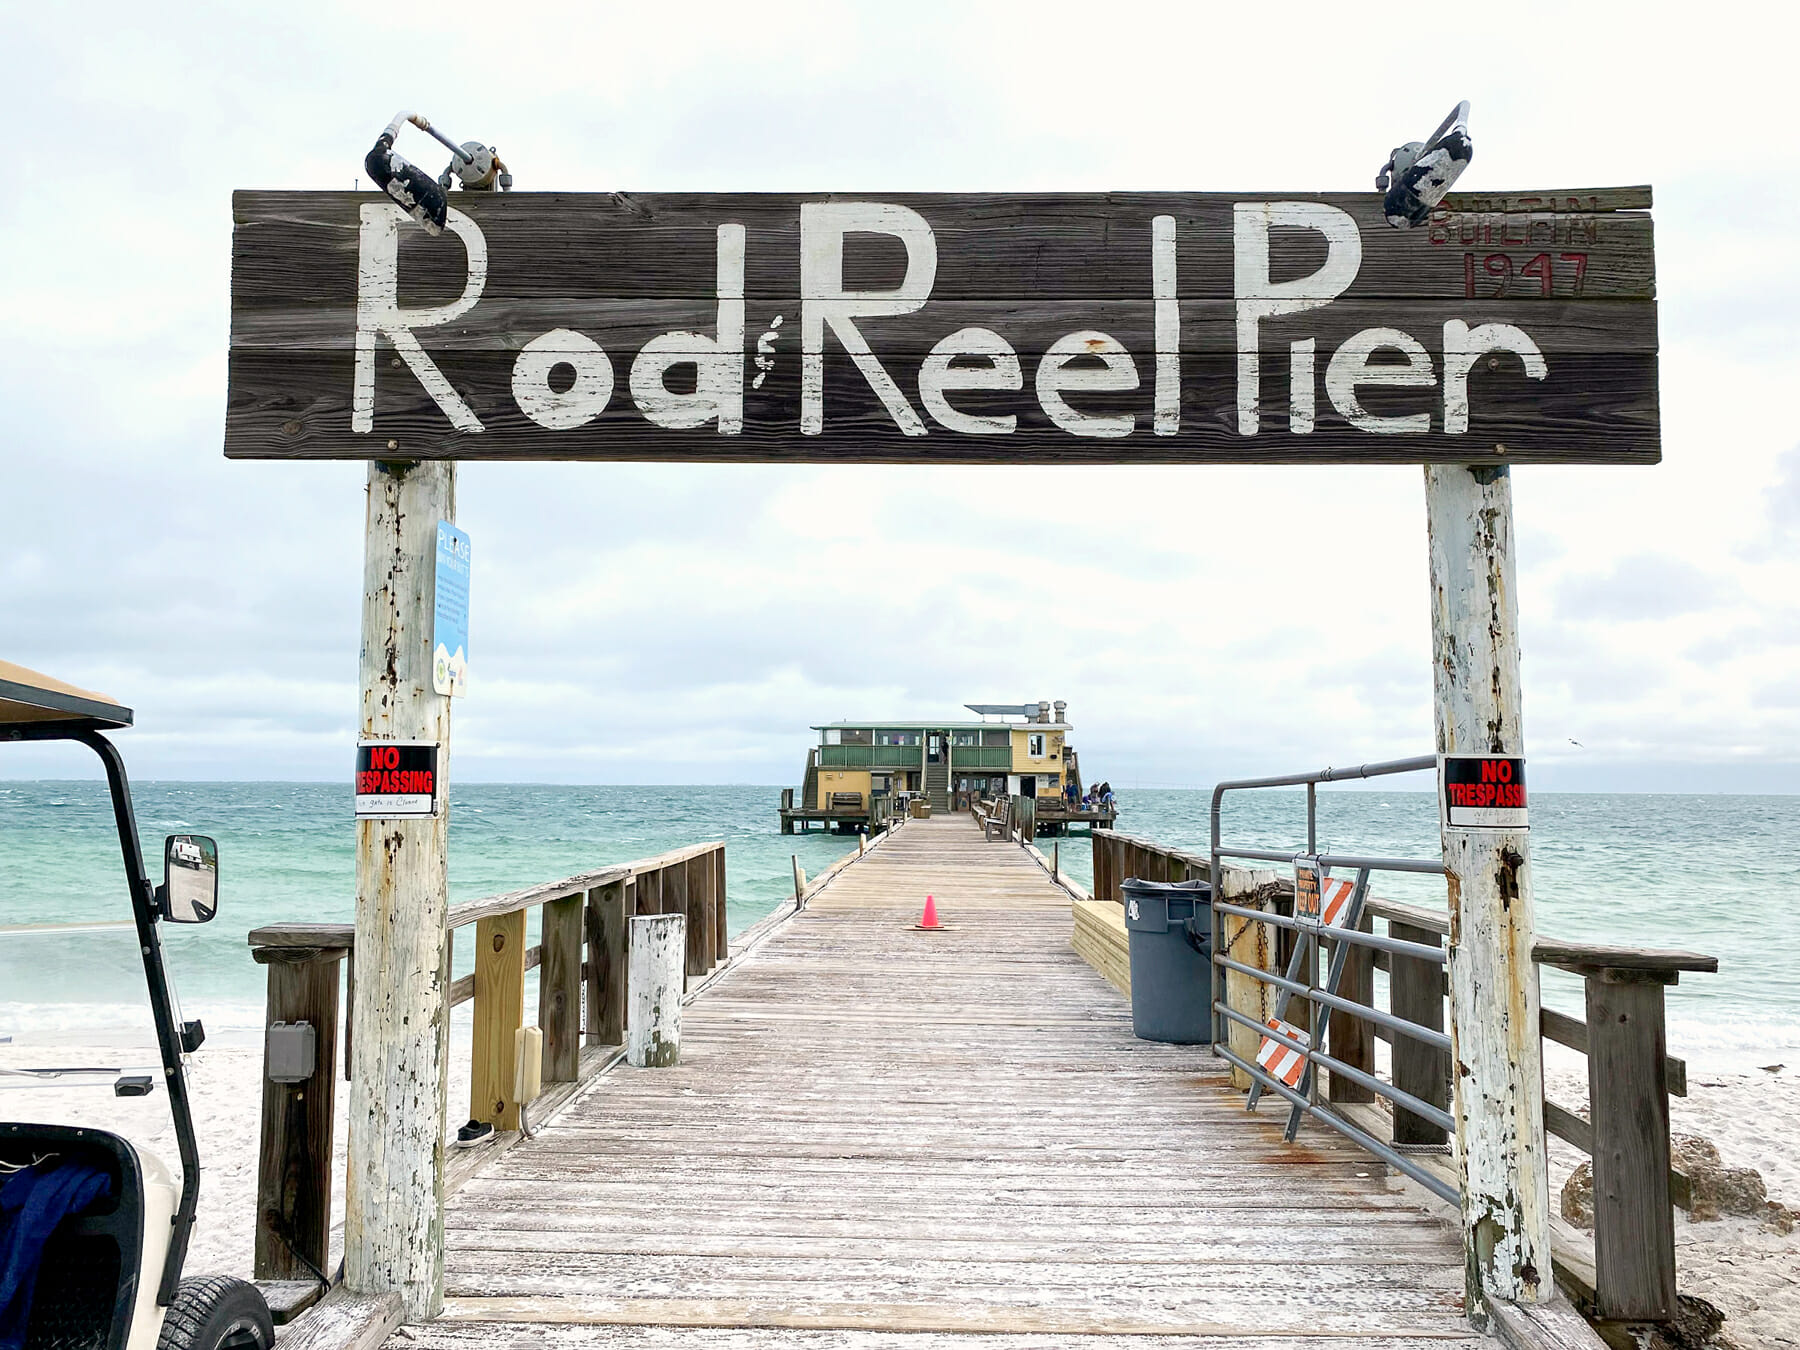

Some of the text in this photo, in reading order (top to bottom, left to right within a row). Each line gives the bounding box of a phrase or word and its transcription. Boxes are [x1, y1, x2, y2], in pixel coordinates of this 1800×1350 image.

[1464, 252, 1588, 298] 1947
[352, 203, 745, 434] Rod
[800, 202, 1180, 437] Reel
[1234, 202, 1549, 436] Pier
[371, 747, 400, 770] NO
[356, 770, 433, 793] ESPASSING
[1481, 760, 1512, 783] NO
